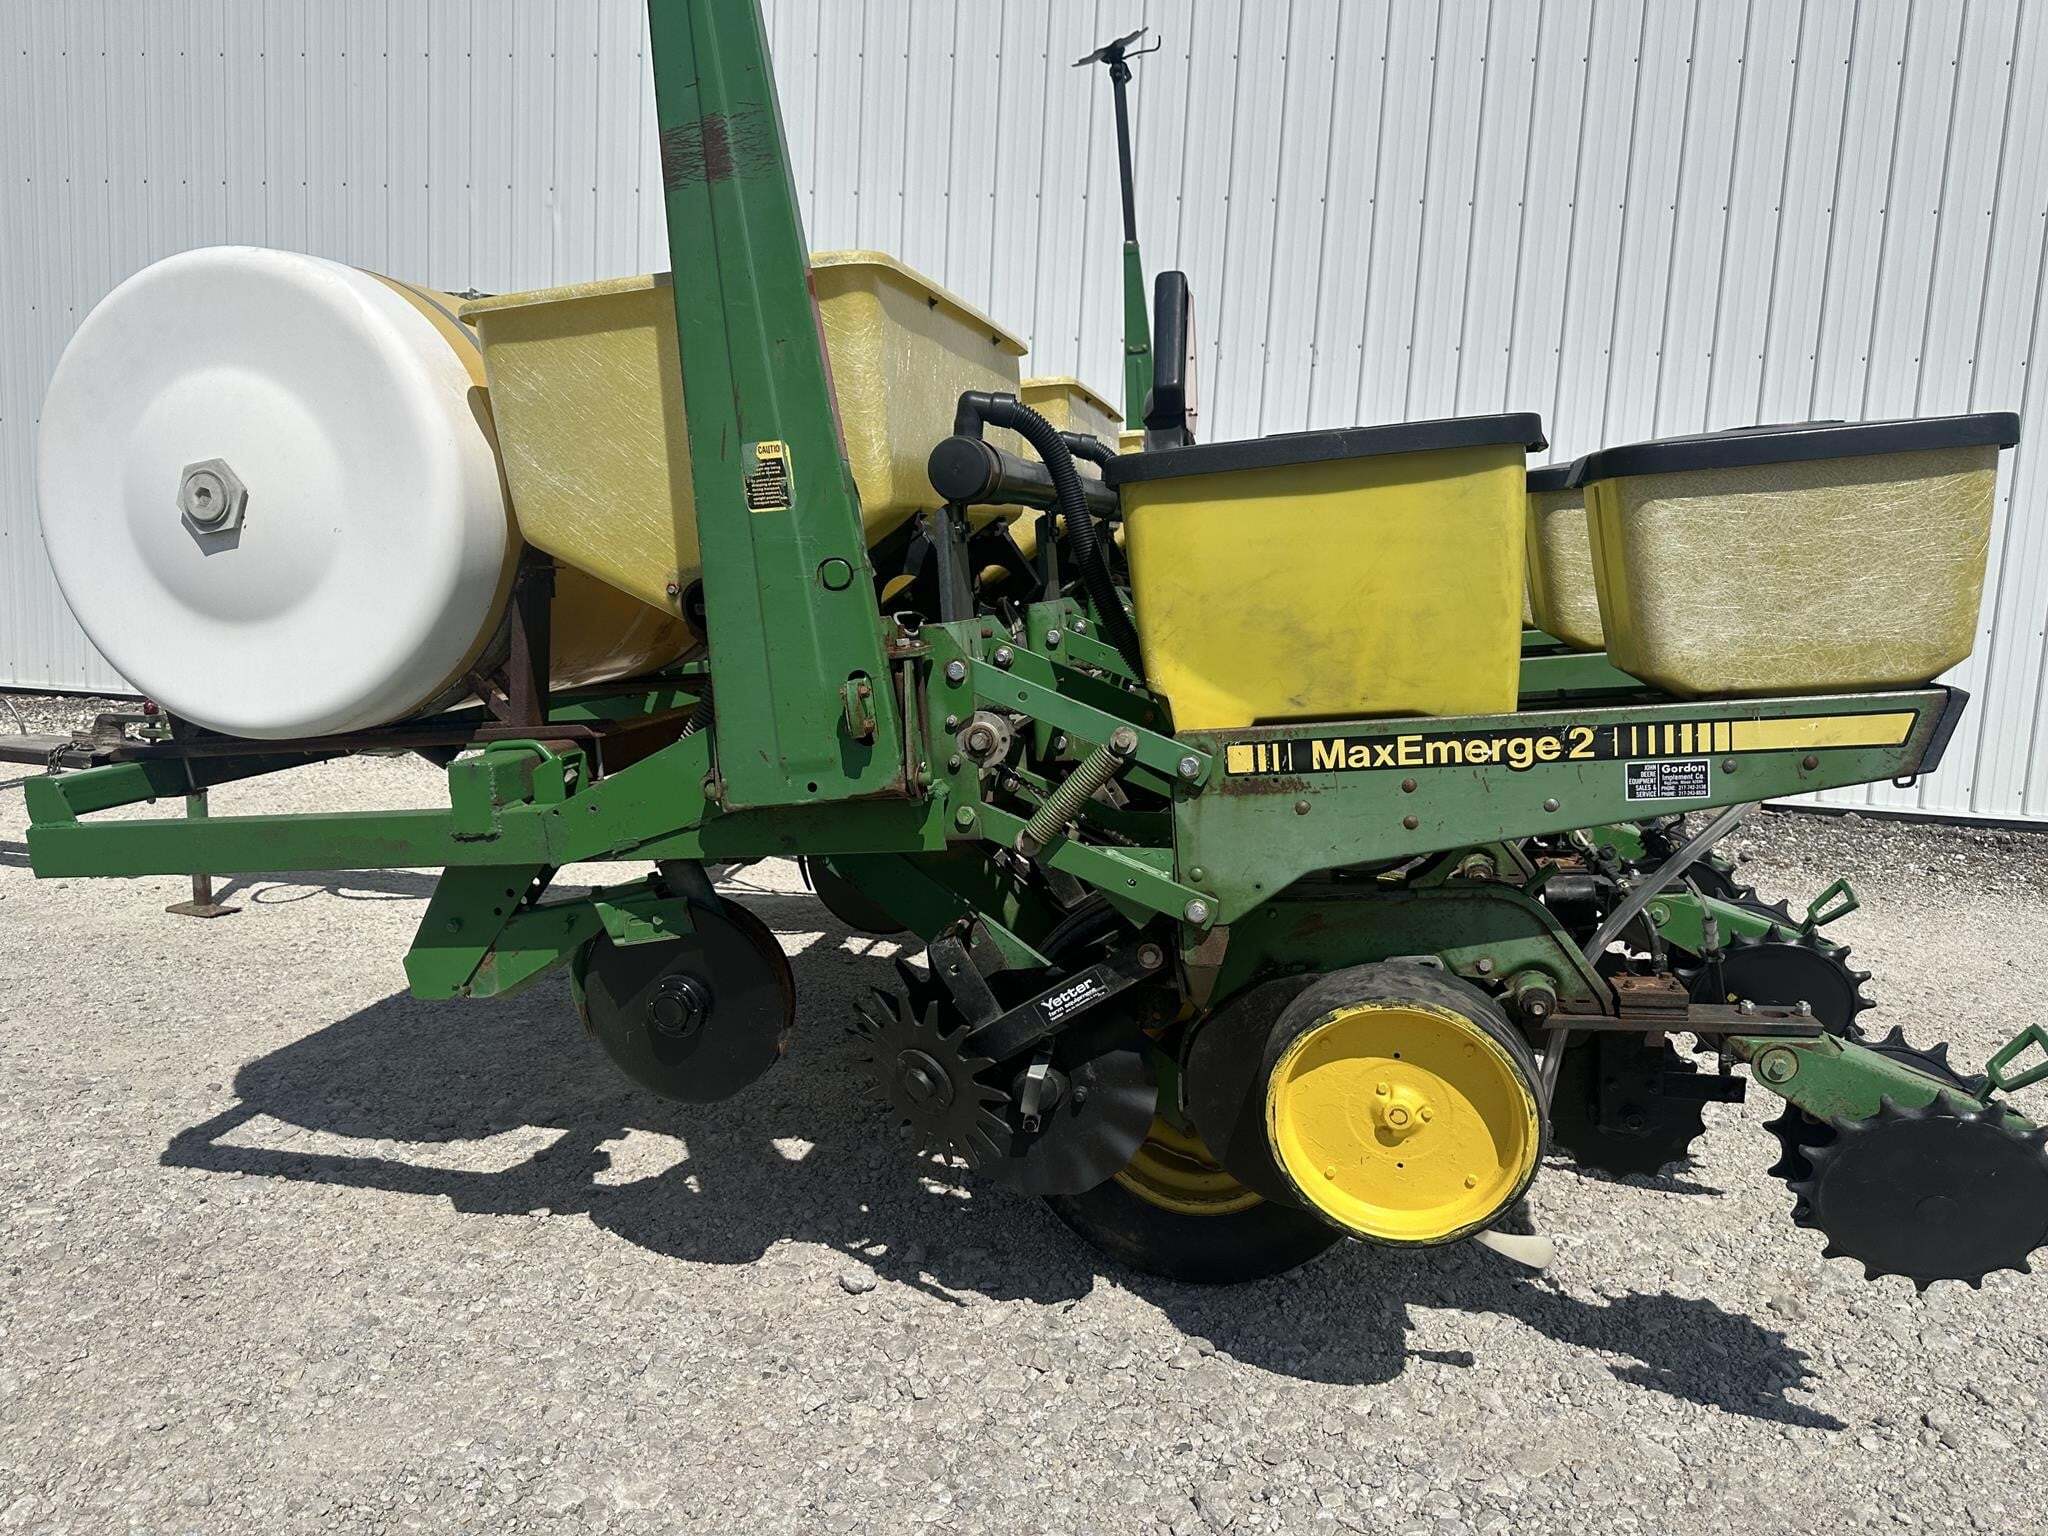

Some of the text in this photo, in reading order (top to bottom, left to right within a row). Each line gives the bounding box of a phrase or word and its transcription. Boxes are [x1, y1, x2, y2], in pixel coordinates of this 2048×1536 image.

[757, 444, 780, 454] CAUTIO
[1661, 763, 1705, 773] Gordon
[1662, 773, 1693, 782] Implement
[1041, 979, 1092, 1010] Yetter
